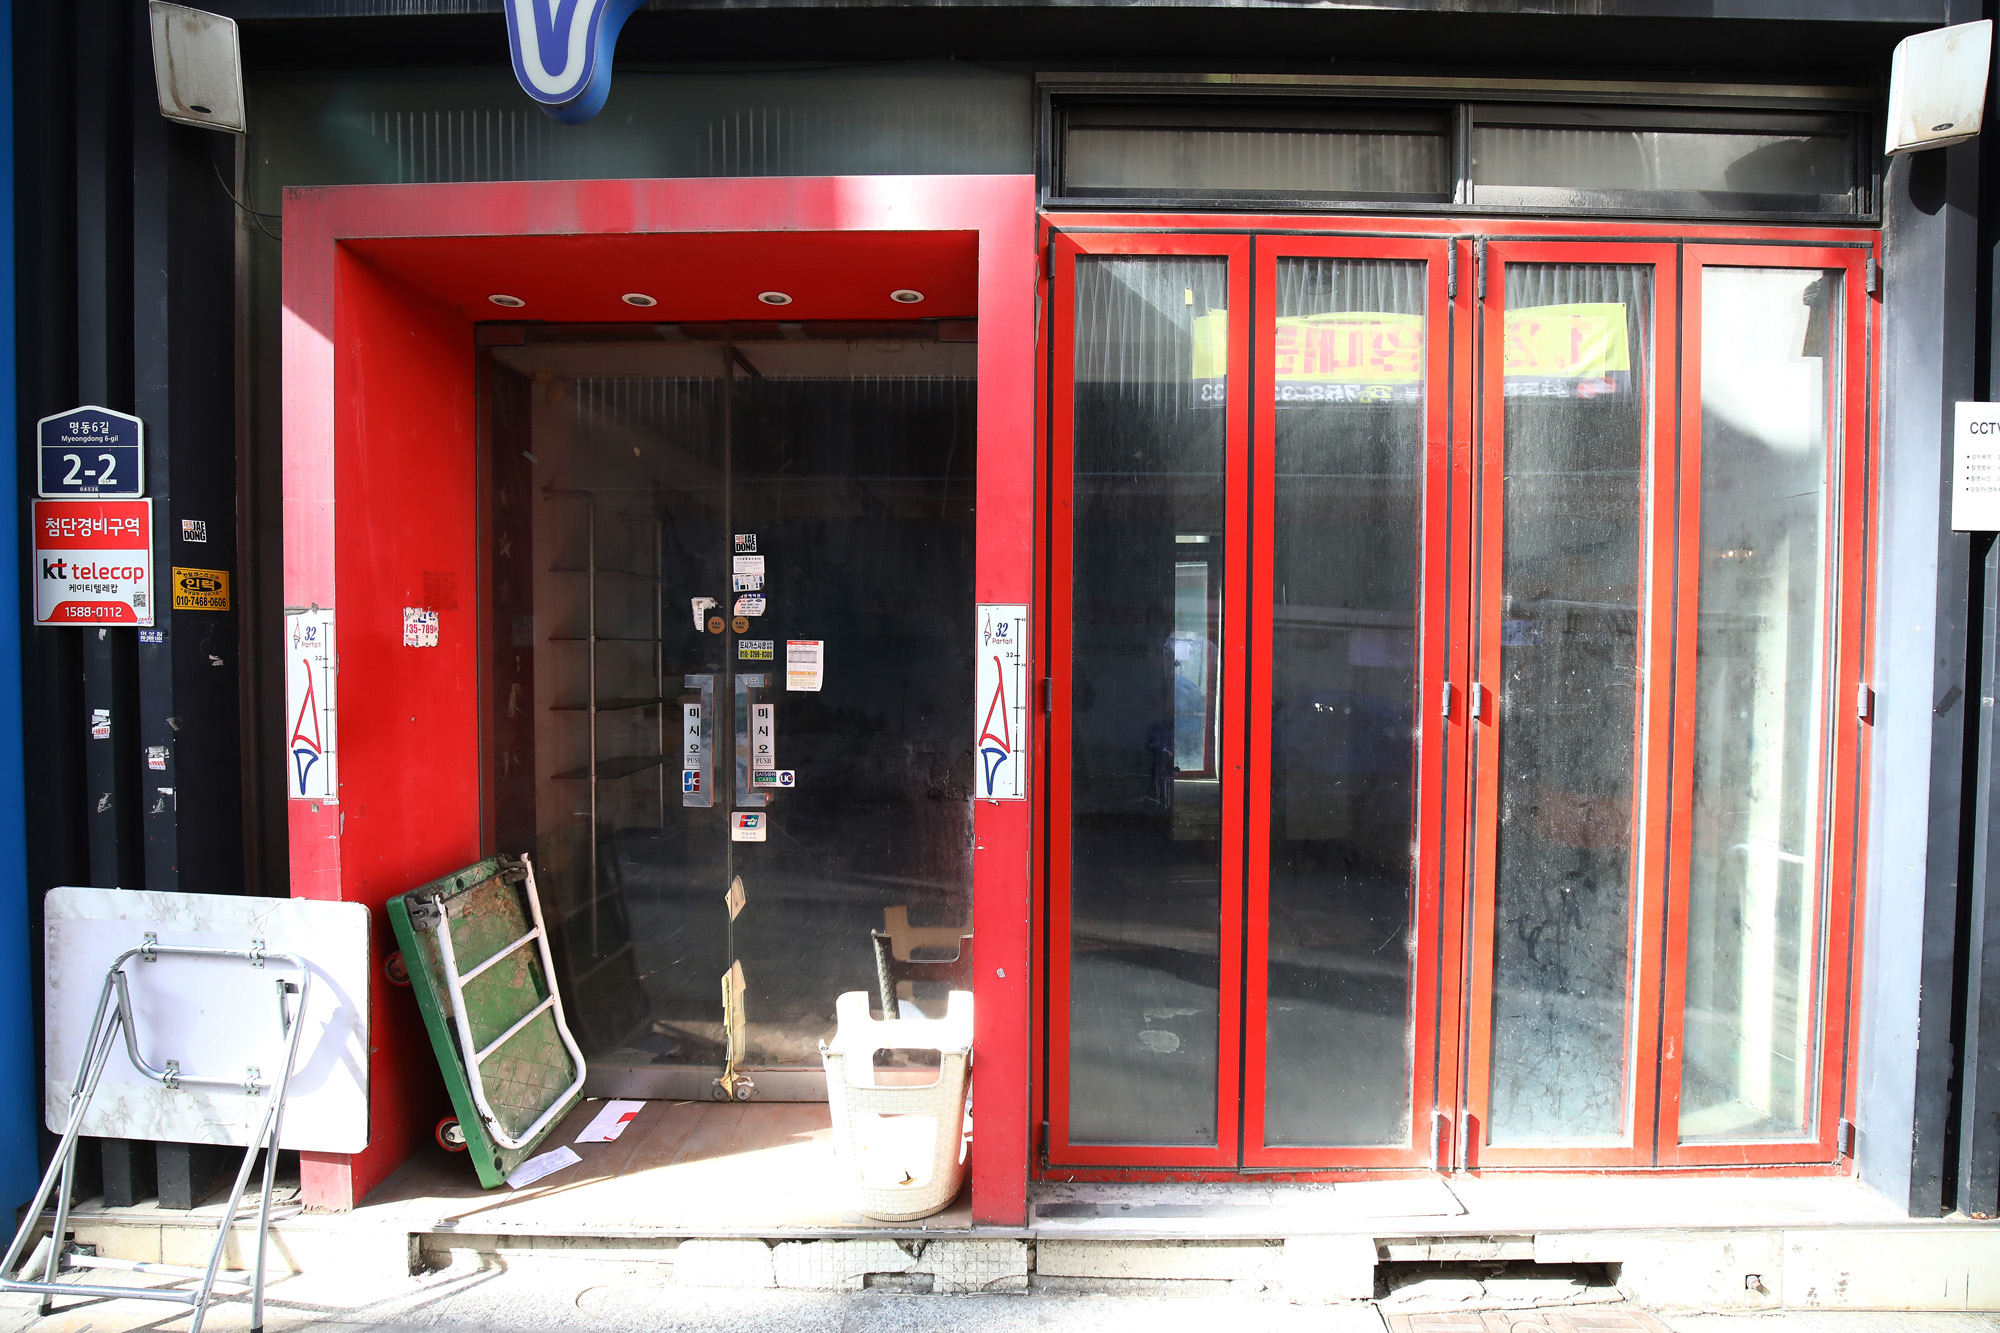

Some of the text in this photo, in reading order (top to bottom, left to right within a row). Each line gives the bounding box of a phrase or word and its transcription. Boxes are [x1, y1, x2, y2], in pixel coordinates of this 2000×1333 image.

[69, 421, 109, 434] 명동6길
[61, 435, 118, 443] Myeongdong 6-gil
[62, 453, 118, 485] 2-2
[45, 517, 140, 537] 첨단경비구역
[192, 521, 205, 531] JAE
[184, 530, 206, 540] DONG
[744, 535, 756, 543] JAE
[736, 543, 756, 551] DONG
[43, 558, 144, 584] kt telecop
[68, 584, 118, 593] 케이티텔레캅
[185, 578, 215, 591] 인력
[176, 596, 227, 607] 010-7468-0606
[64, 607, 122, 618] 1588-0112
[304, 627, 317, 641] 32
[996, 622, 1009, 638] 32
[688, 707, 700, 754] 미시오
[758, 707, 769, 754] 미시오
[780, 774, 793, 783] UC
